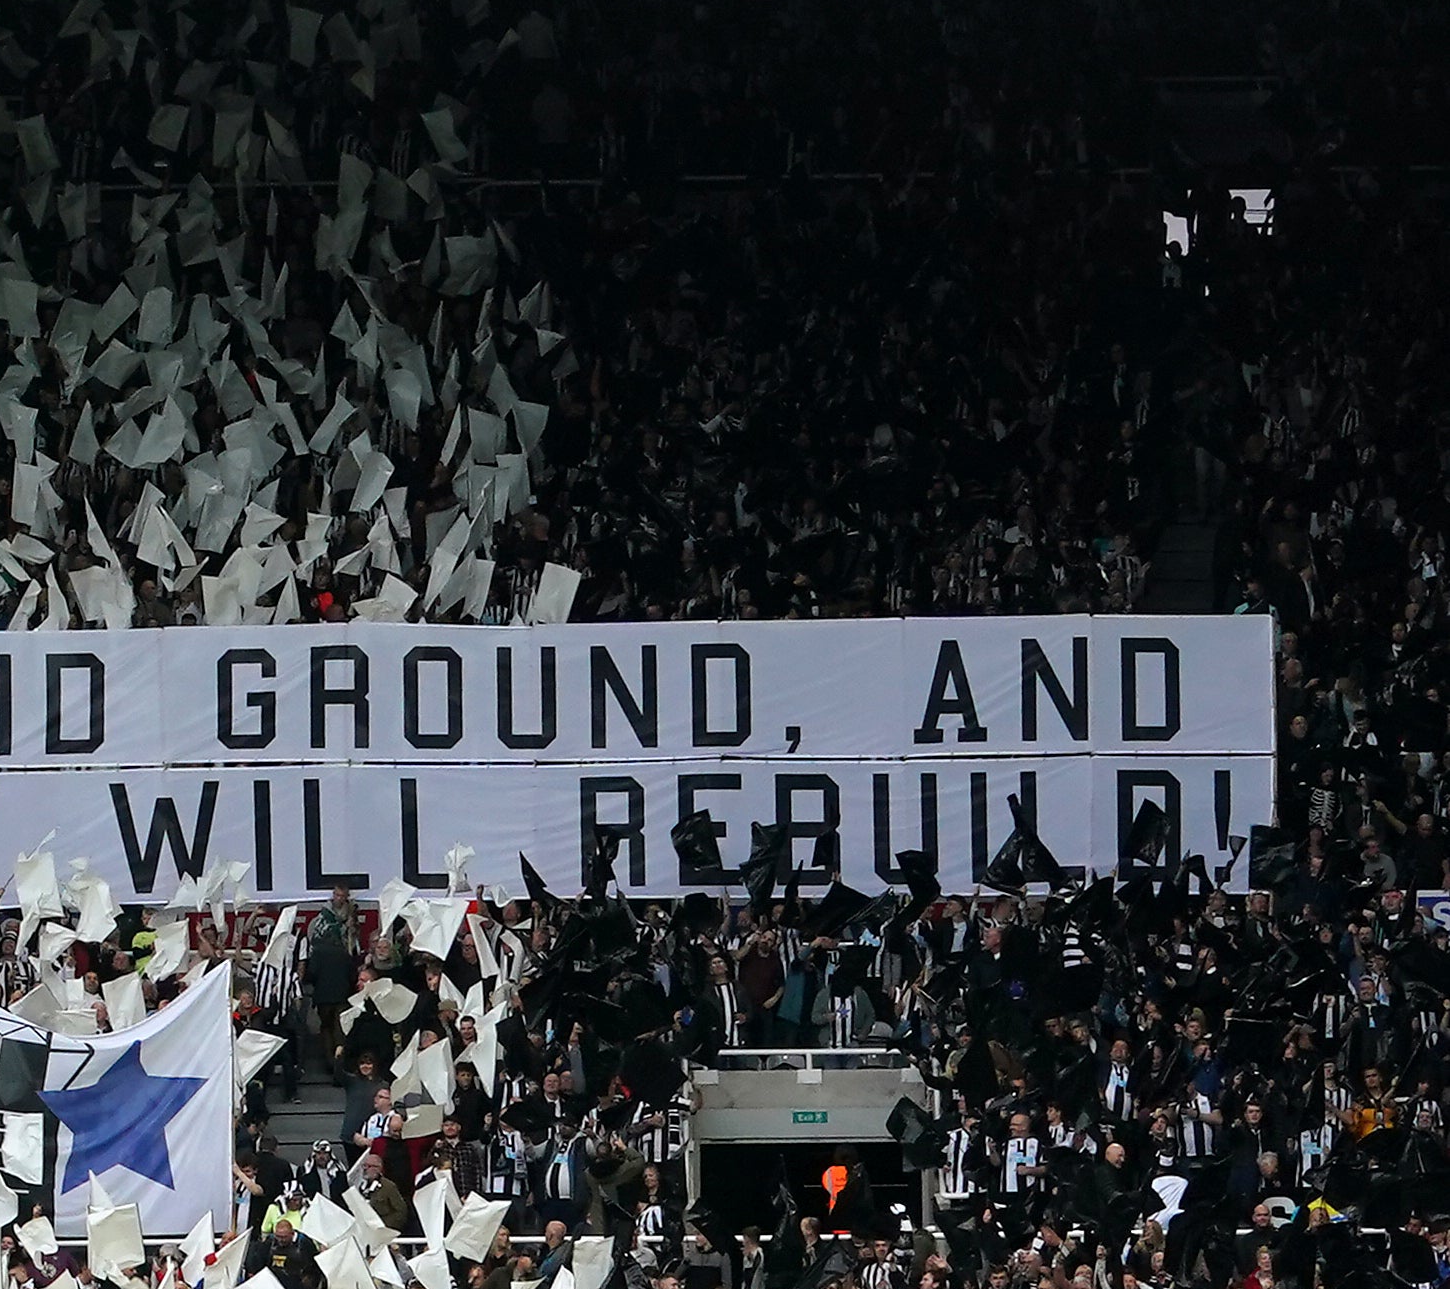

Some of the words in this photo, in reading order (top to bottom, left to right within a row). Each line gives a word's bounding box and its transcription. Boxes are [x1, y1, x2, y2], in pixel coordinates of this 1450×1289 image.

[216, 643, 802, 754] GROUND,
[913, 636, 1182, 745] AND
[108, 777, 453, 894] WILL
[579, 768, 1231, 887] REBUILD!
